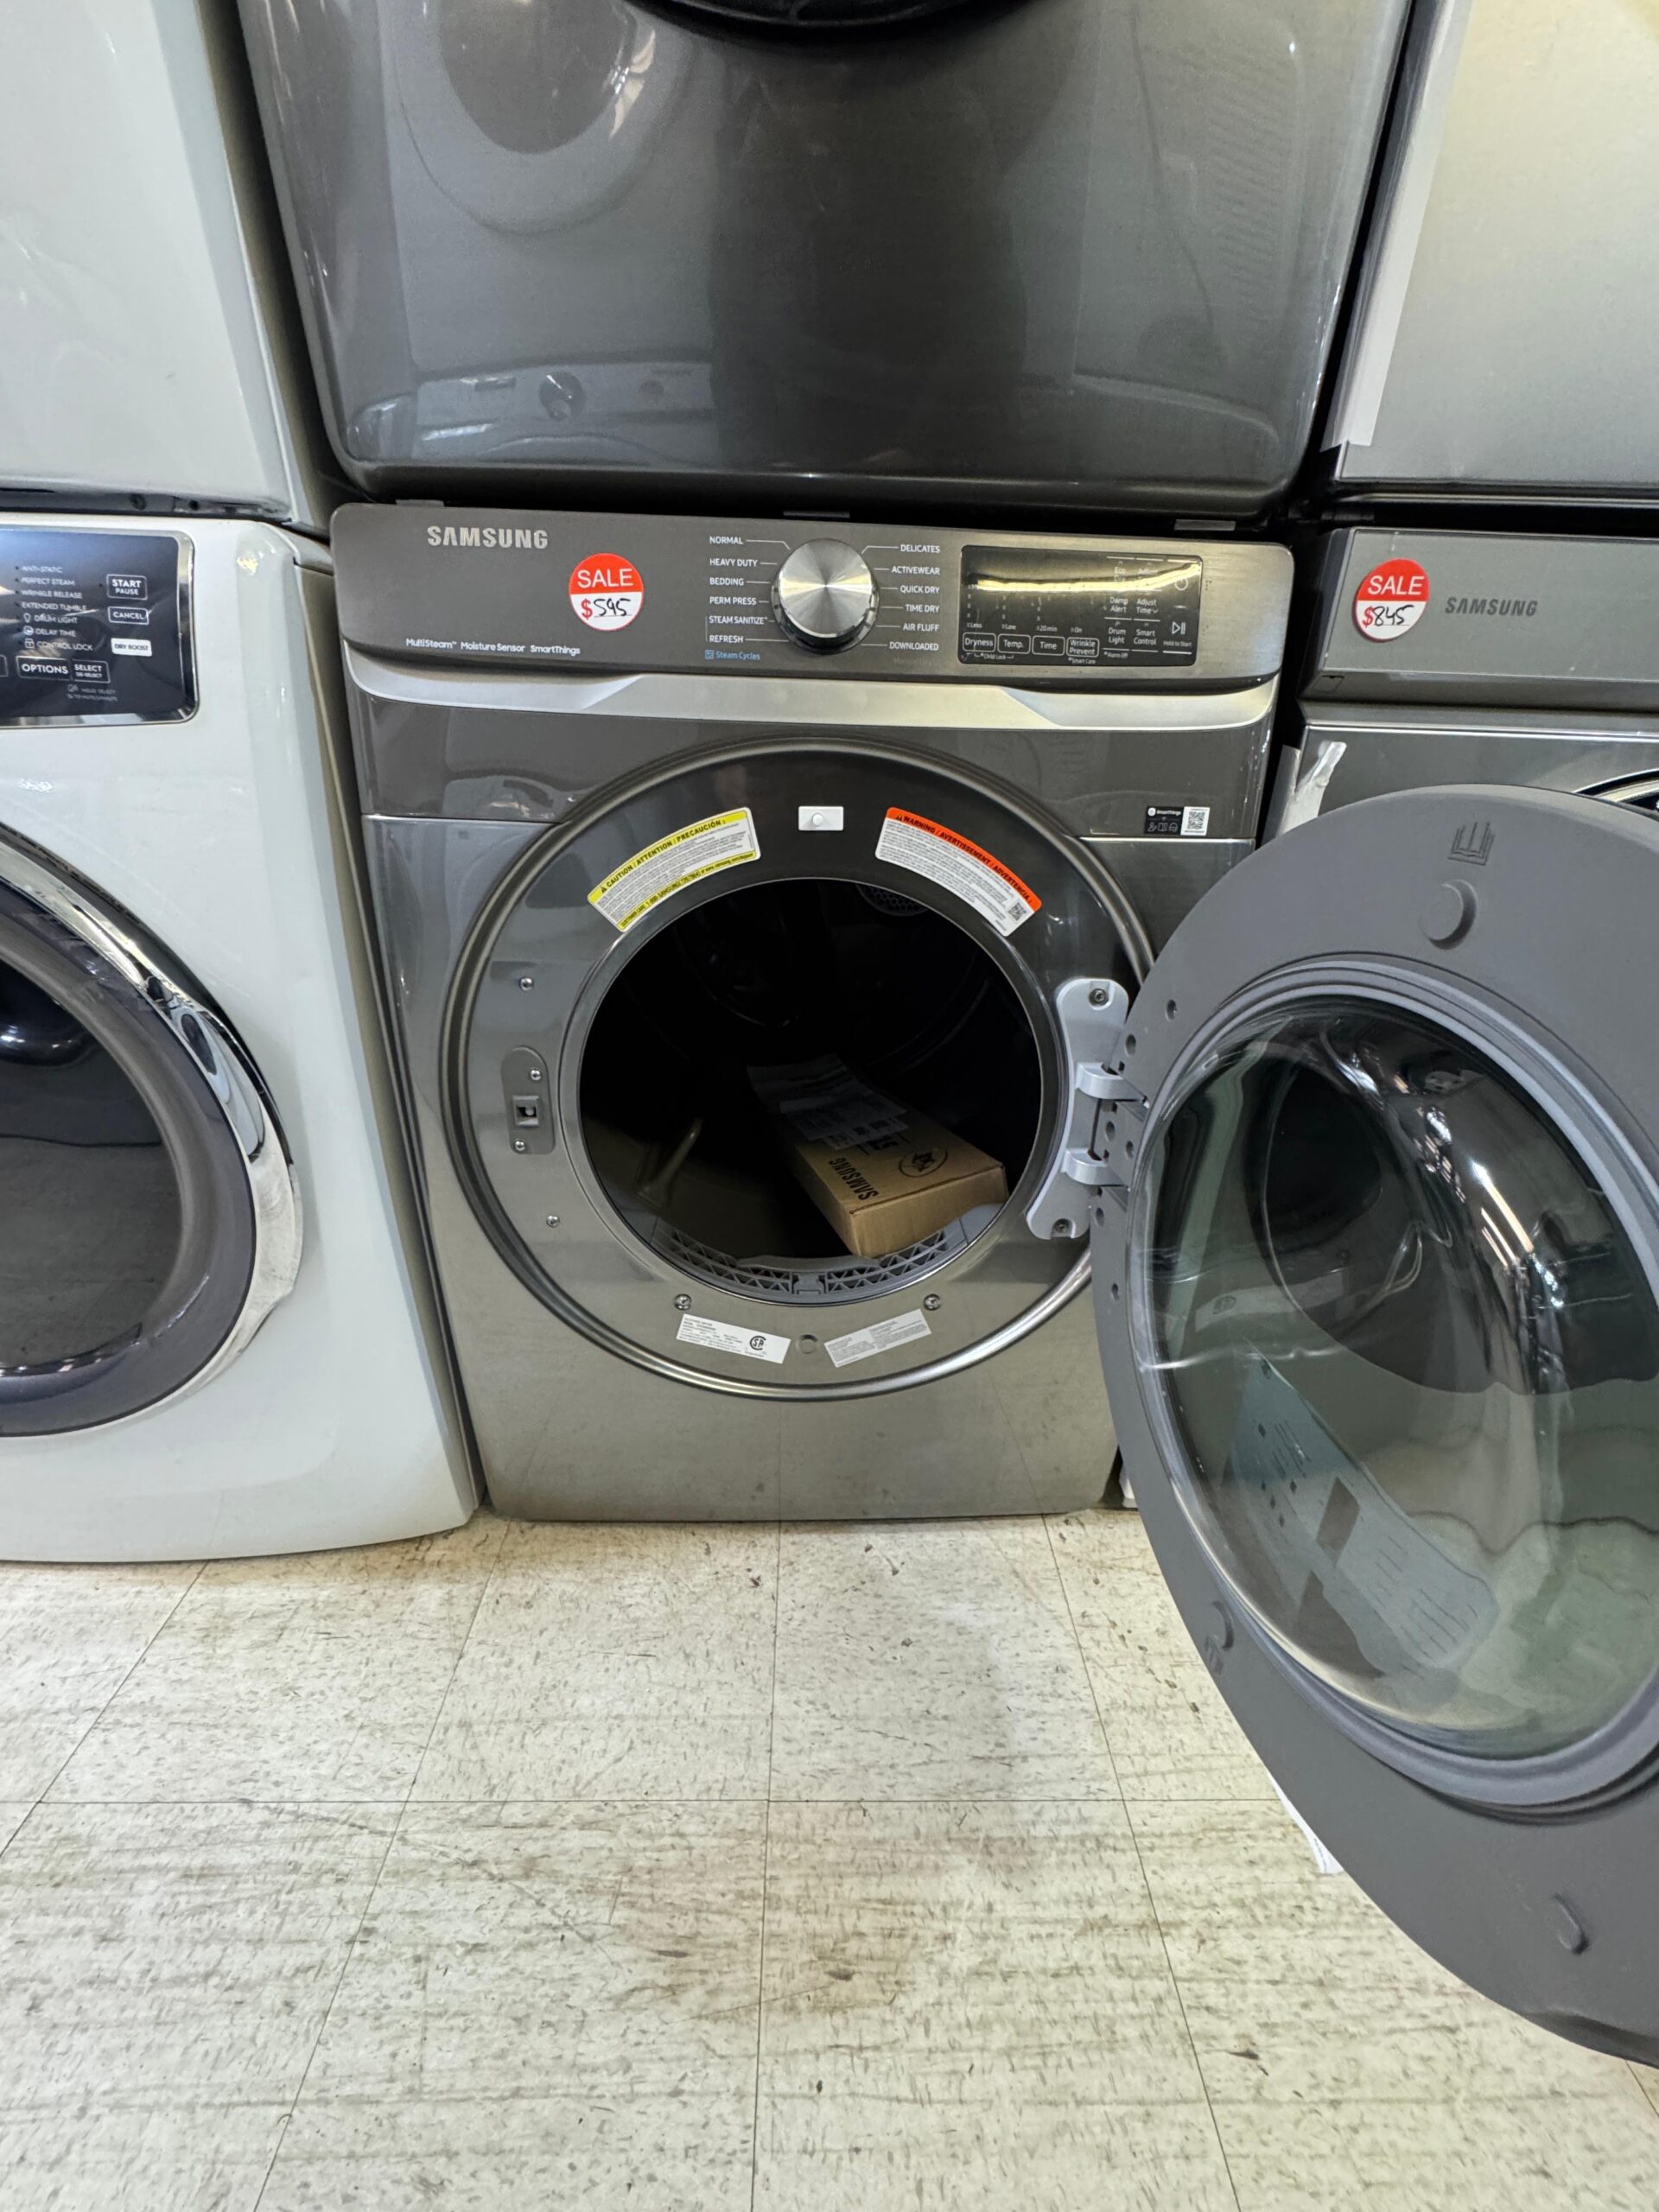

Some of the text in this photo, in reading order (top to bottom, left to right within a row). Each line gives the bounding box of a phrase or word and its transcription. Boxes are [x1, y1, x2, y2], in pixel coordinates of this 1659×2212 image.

[427, 525, 549, 550] SAMSUNG
[709, 536, 744, 545] NORMAL
[900, 544, 941, 554] DELICATES
[709, 558, 758, 568] HEAVY DUTY
[891, 566, 941, 575] ACTIVEWEAR
[111, 579, 143, 588] START
[576, 568, 634, 589] SALE
[709, 577, 745, 587] BEDDING
[899, 585, 940, 594] QUICK DRY
[1367, 575, 1425, 595] SALE
[22, 601, 87, 612] EXTENDED TUMBLE
[709, 597, 757, 606] PERM PRESS
[1109, 596, 1128, 607] Damp
[1136, 598, 1157, 607] Adjust
[906, 604, 940, 613] TIME DRY
[1445, 597, 1539, 618] SAMSUNG
[112, 611, 144, 620] CANCEL
[709, 615, 732, 625] STEAM
[903, 623, 940, 632] AIR FLUFF
[709, 635, 744, 644] REFRESH
[964, 638, 994, 648] Dryness
[1003, 639, 1024, 648] Temp.
[1070, 639, 1096, 648] Wrinkle
[1109, 636, 1125, 645] Light
[1134, 637, 1157, 645] Control
[36, 641, 93, 652] CONTROL LOCK
[461, 642, 496, 652] Moisture
[497, 643, 525, 653] Sensor
[531, 645, 581, 657] SmartThings
[889, 641, 939, 652] DOWNLOADED
[1039, 641, 1058, 650] Time
[715, 652, 760, 661] Steam Cycles
[21, 663, 69, 675] OPTIONS
[73, 664, 103, 672] SELECT
[606, 862, 633, 888] CAUTION
[636, 840, 673, 867] ATTENTION
[676, 818, 721, 842] PRECAUCIÓN
[902, 815, 936, 834] WARNING
[939, 831, 991, 865] AVERTISSEMENT
[993, 865, 1030, 901] ADVERTENCIA
[829, 1157, 879, 1201] SAMSUNG
